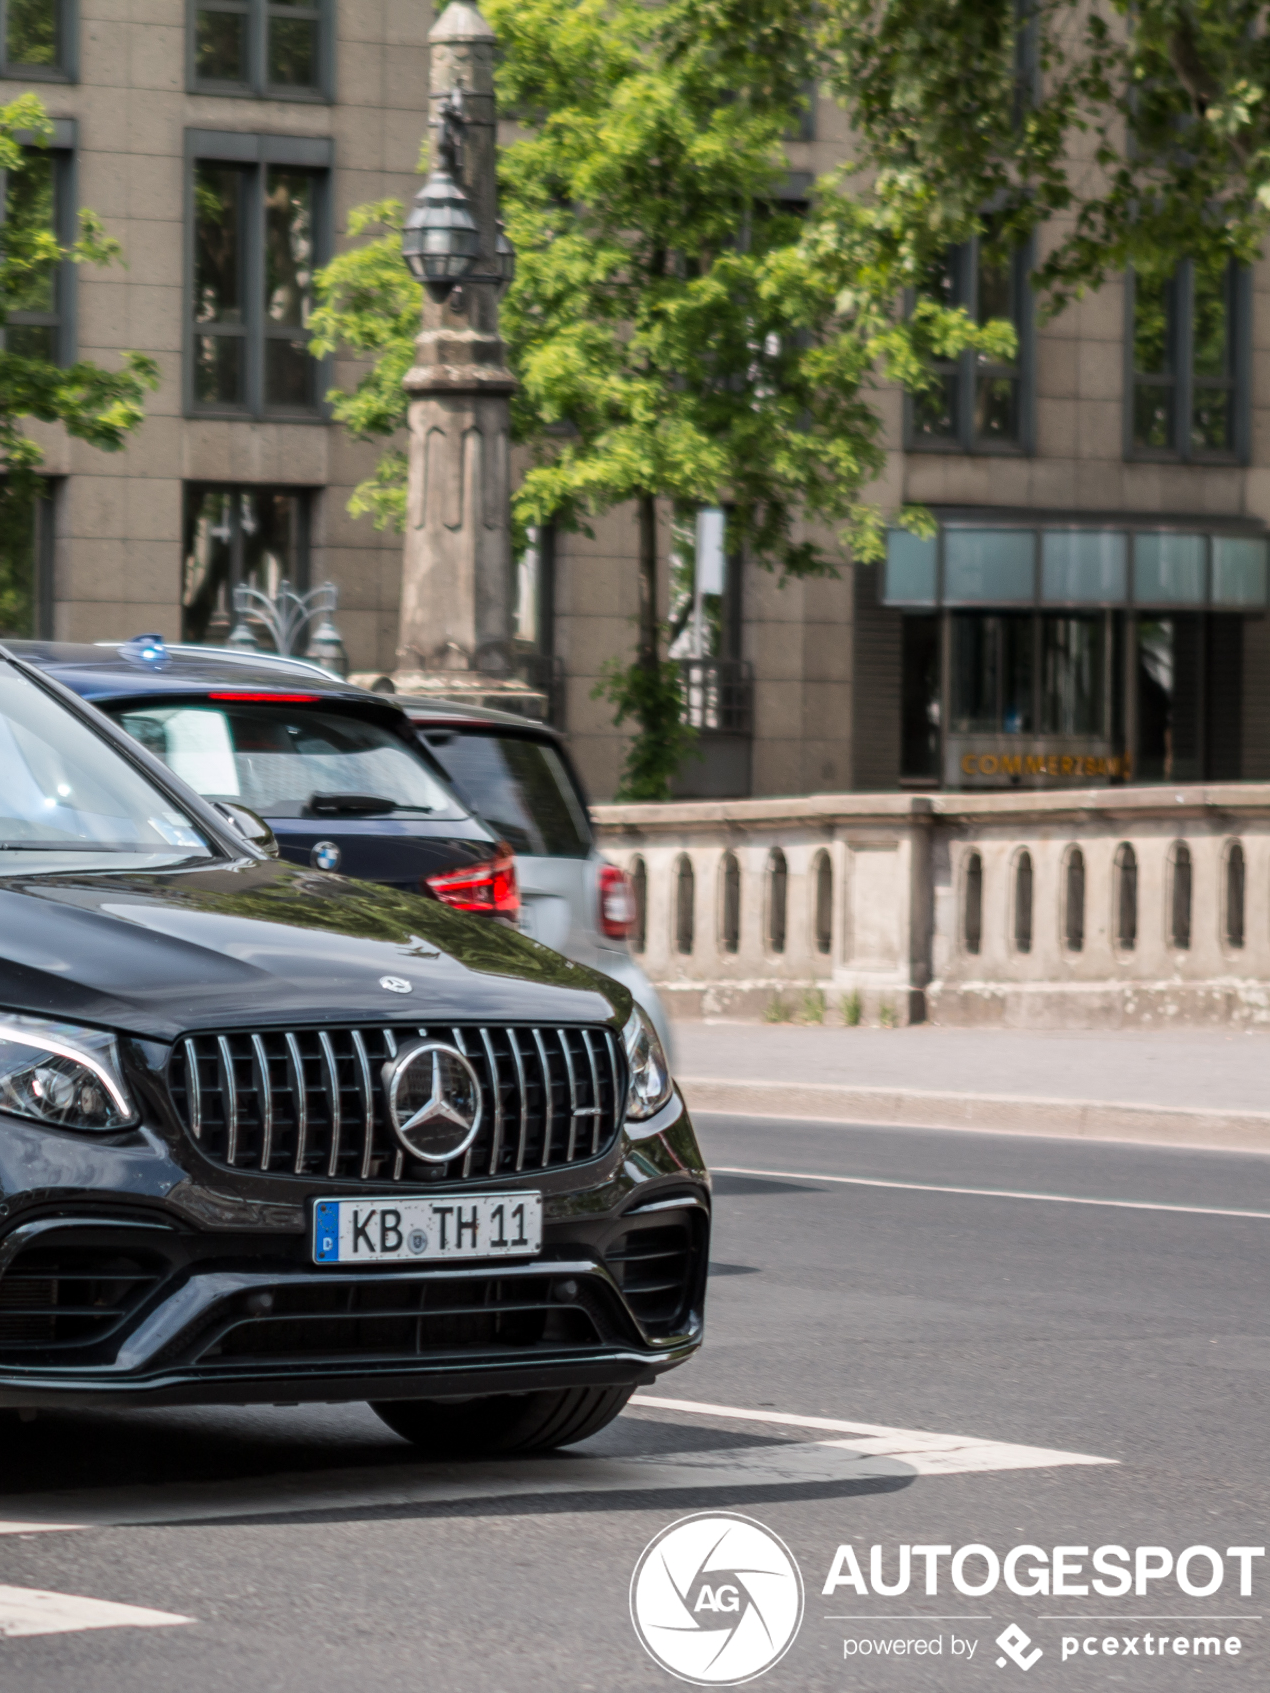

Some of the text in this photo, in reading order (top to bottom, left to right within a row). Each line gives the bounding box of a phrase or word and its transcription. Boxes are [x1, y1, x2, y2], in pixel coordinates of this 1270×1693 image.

[322, 1237, 333, 1251] D
[352, 1203, 529, 1253] KB TH 11
